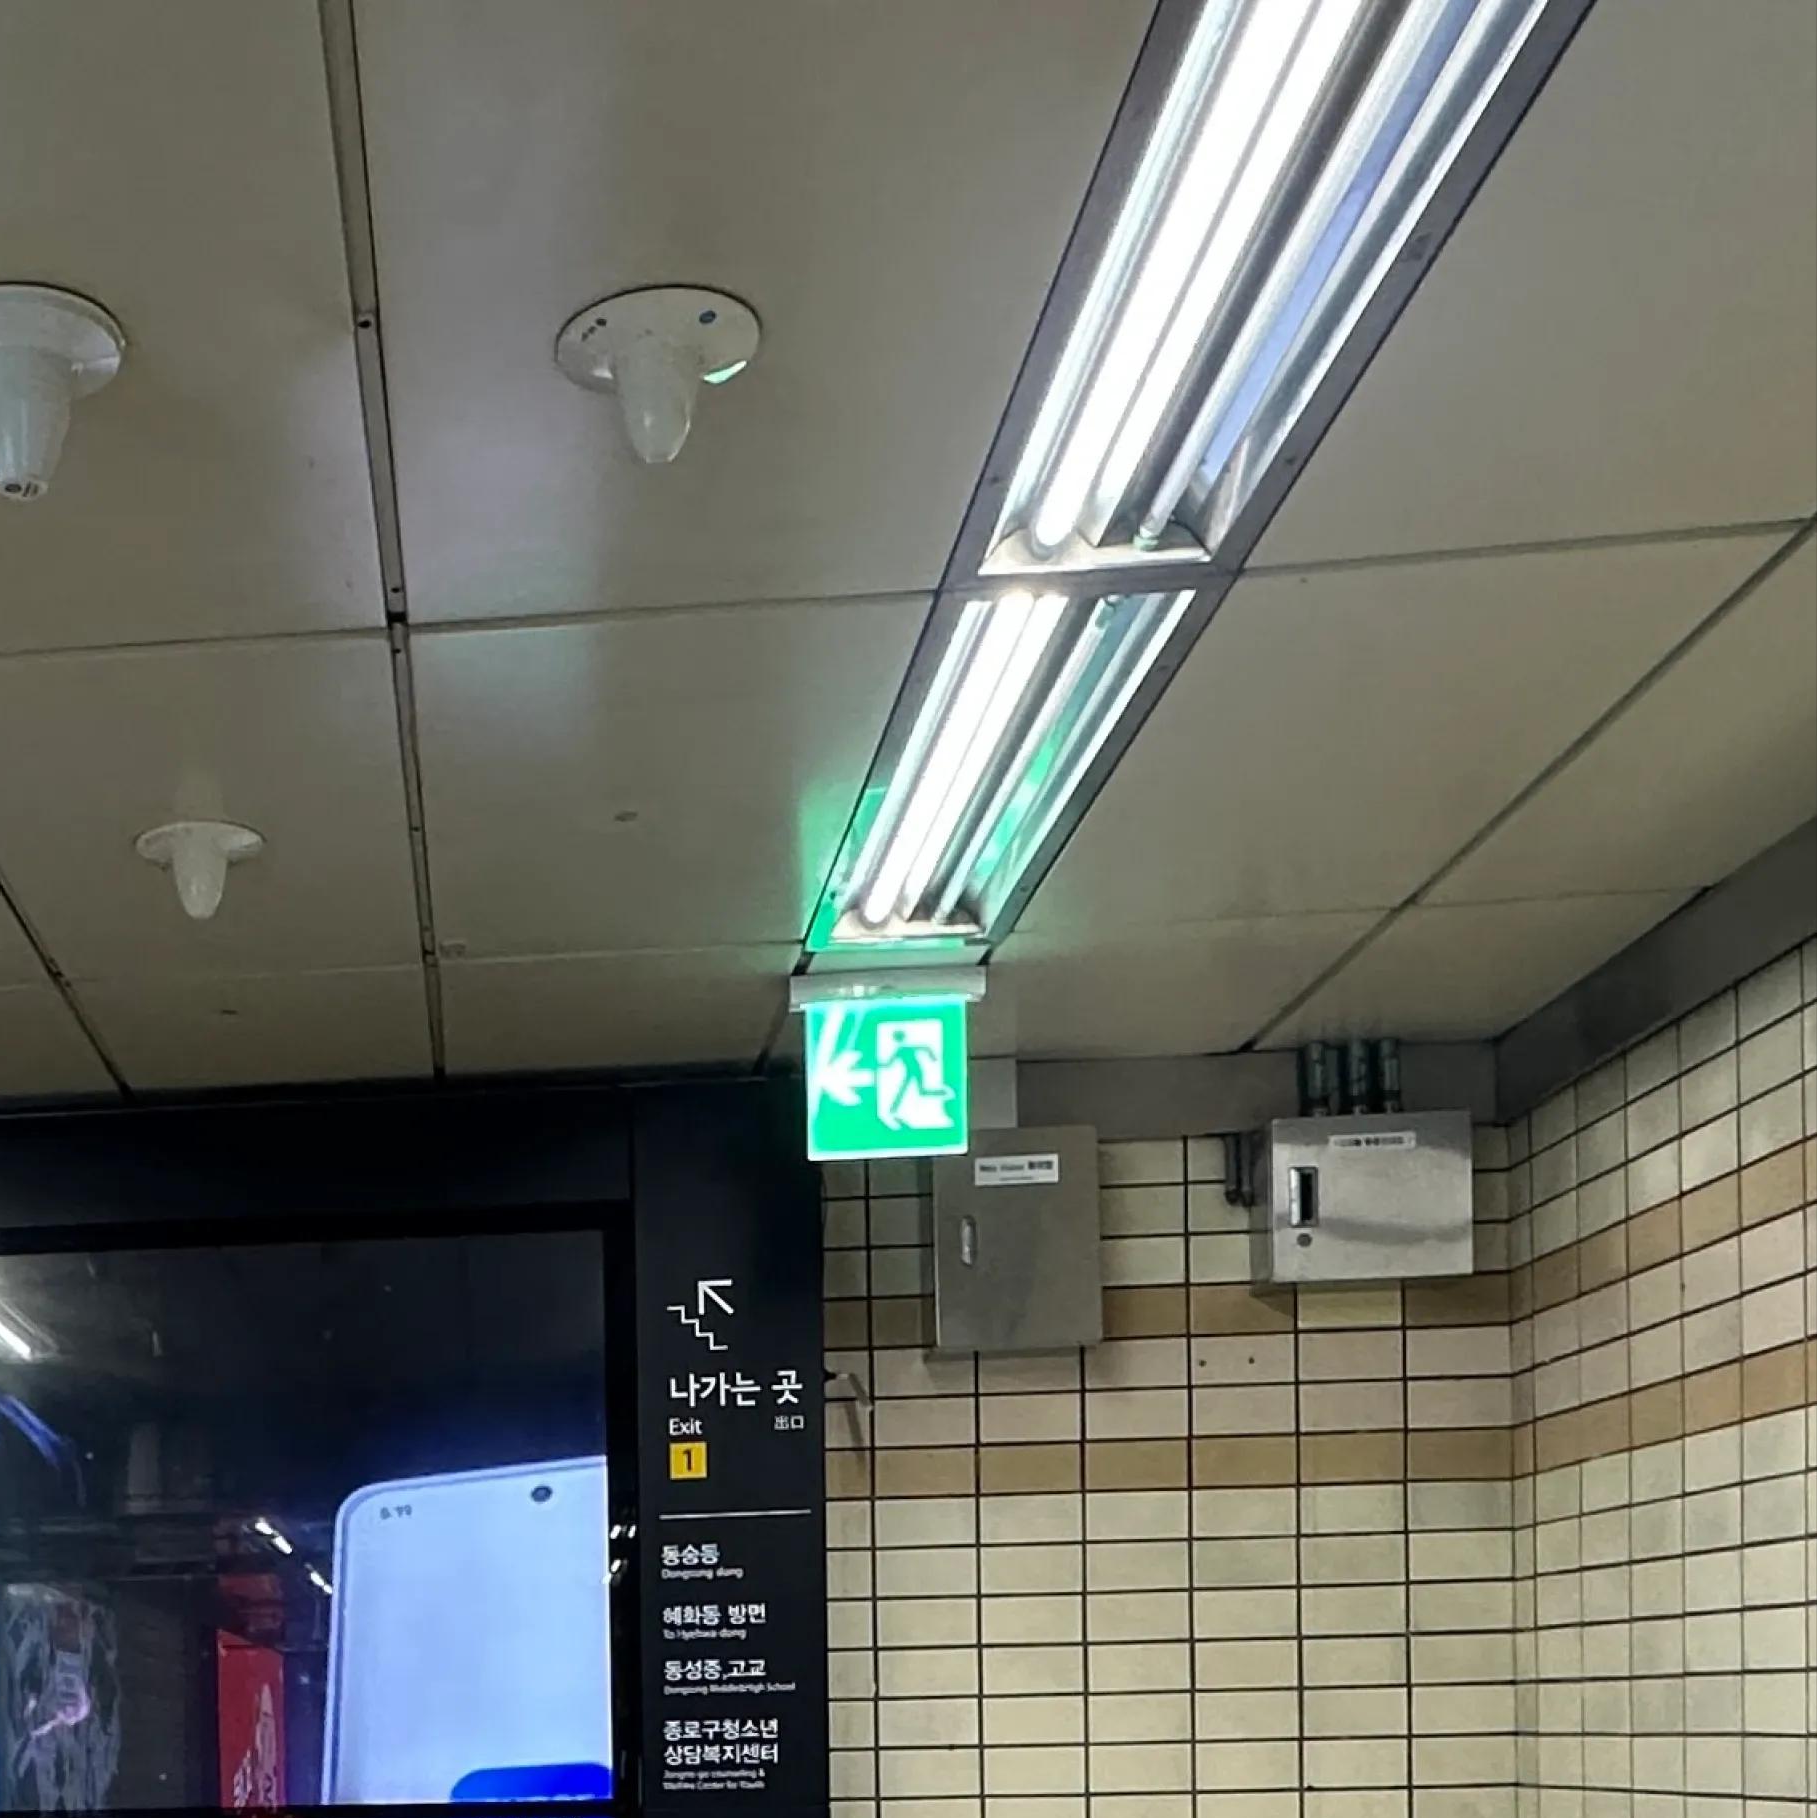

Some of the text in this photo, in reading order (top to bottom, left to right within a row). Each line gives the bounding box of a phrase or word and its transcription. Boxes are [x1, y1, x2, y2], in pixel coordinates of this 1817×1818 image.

[670, 1370, 803, 1407] 나가는 곳
[669, 1418, 703, 1435] Exit
[774, 1415, 804, 1430] 出口
[661, 1544, 720, 1565] 동숭동
[663, 1603, 766, 1626] 혜화동 방면
[663, 1719, 778, 1741] 종로구청소년
[664, 1744, 779, 1766] 상담복지센터
